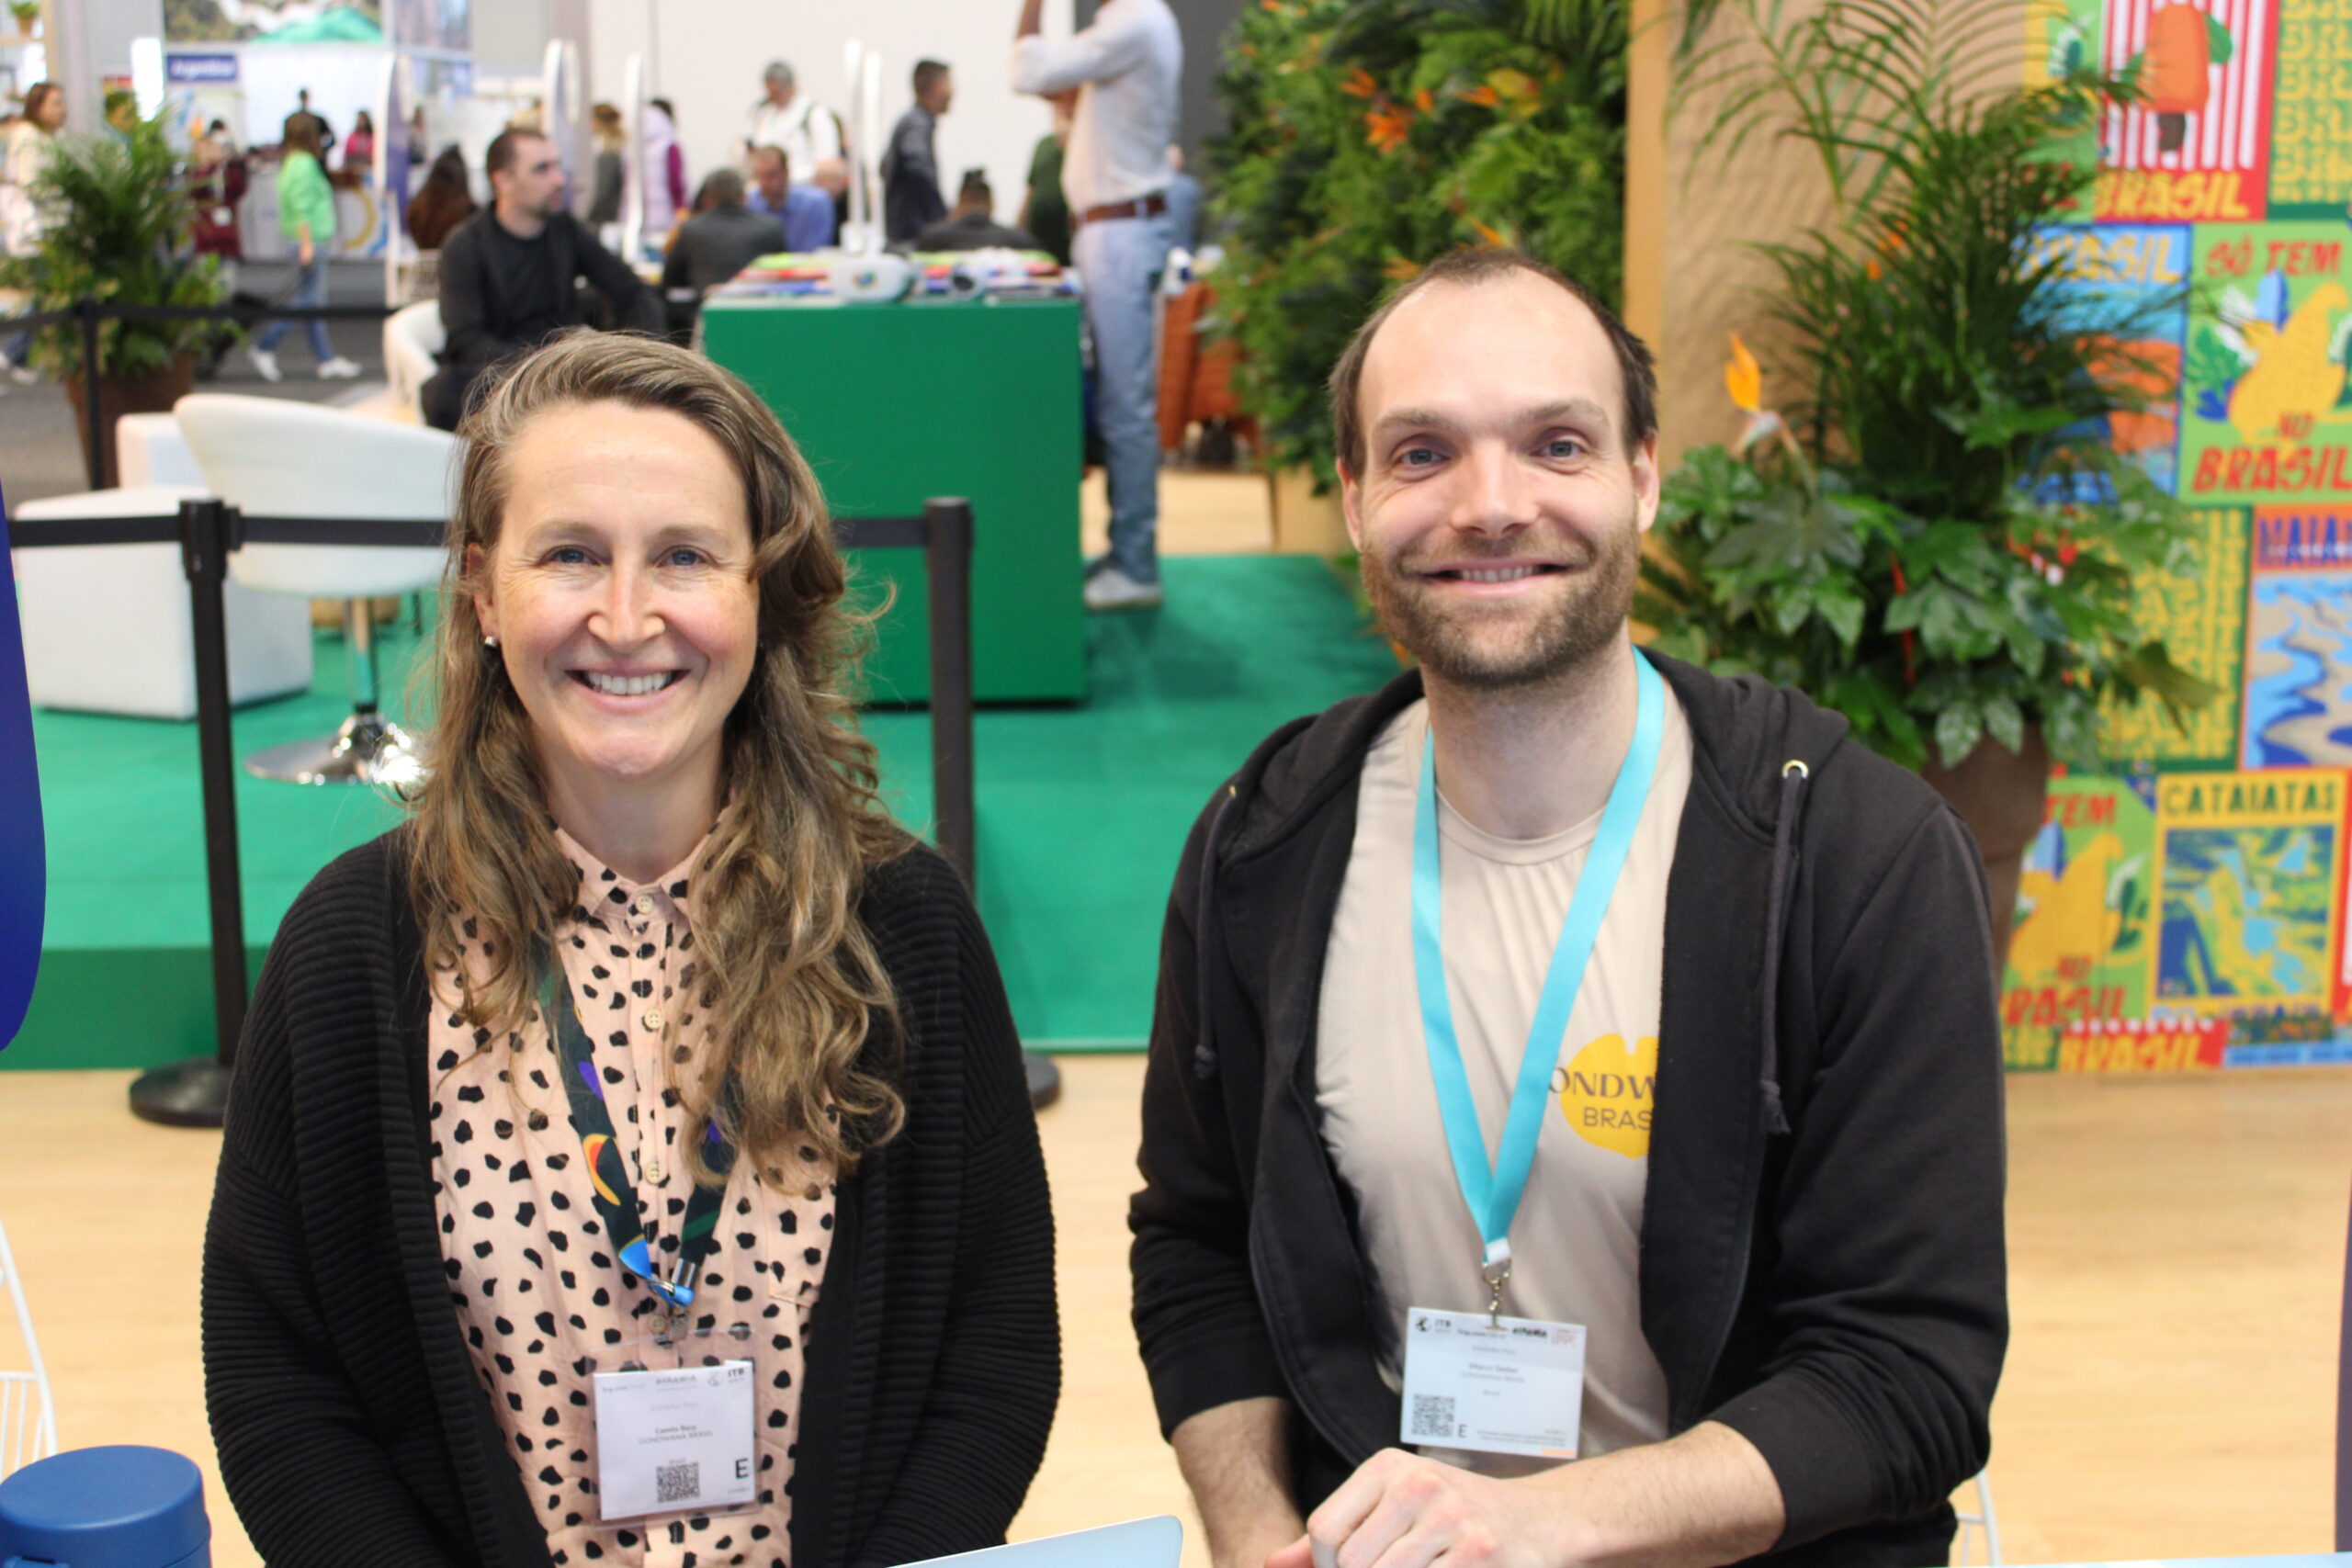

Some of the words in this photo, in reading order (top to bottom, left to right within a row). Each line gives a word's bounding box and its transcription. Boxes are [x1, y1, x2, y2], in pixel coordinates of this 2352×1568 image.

[2266, 240, 2342, 275] TEM
[2193, 446, 2352, 492] BRASIL
[728, 1368, 745, 1378] ITB
[1458, 1425, 1468, 1438] E
[735, 1458, 749, 1479] E
